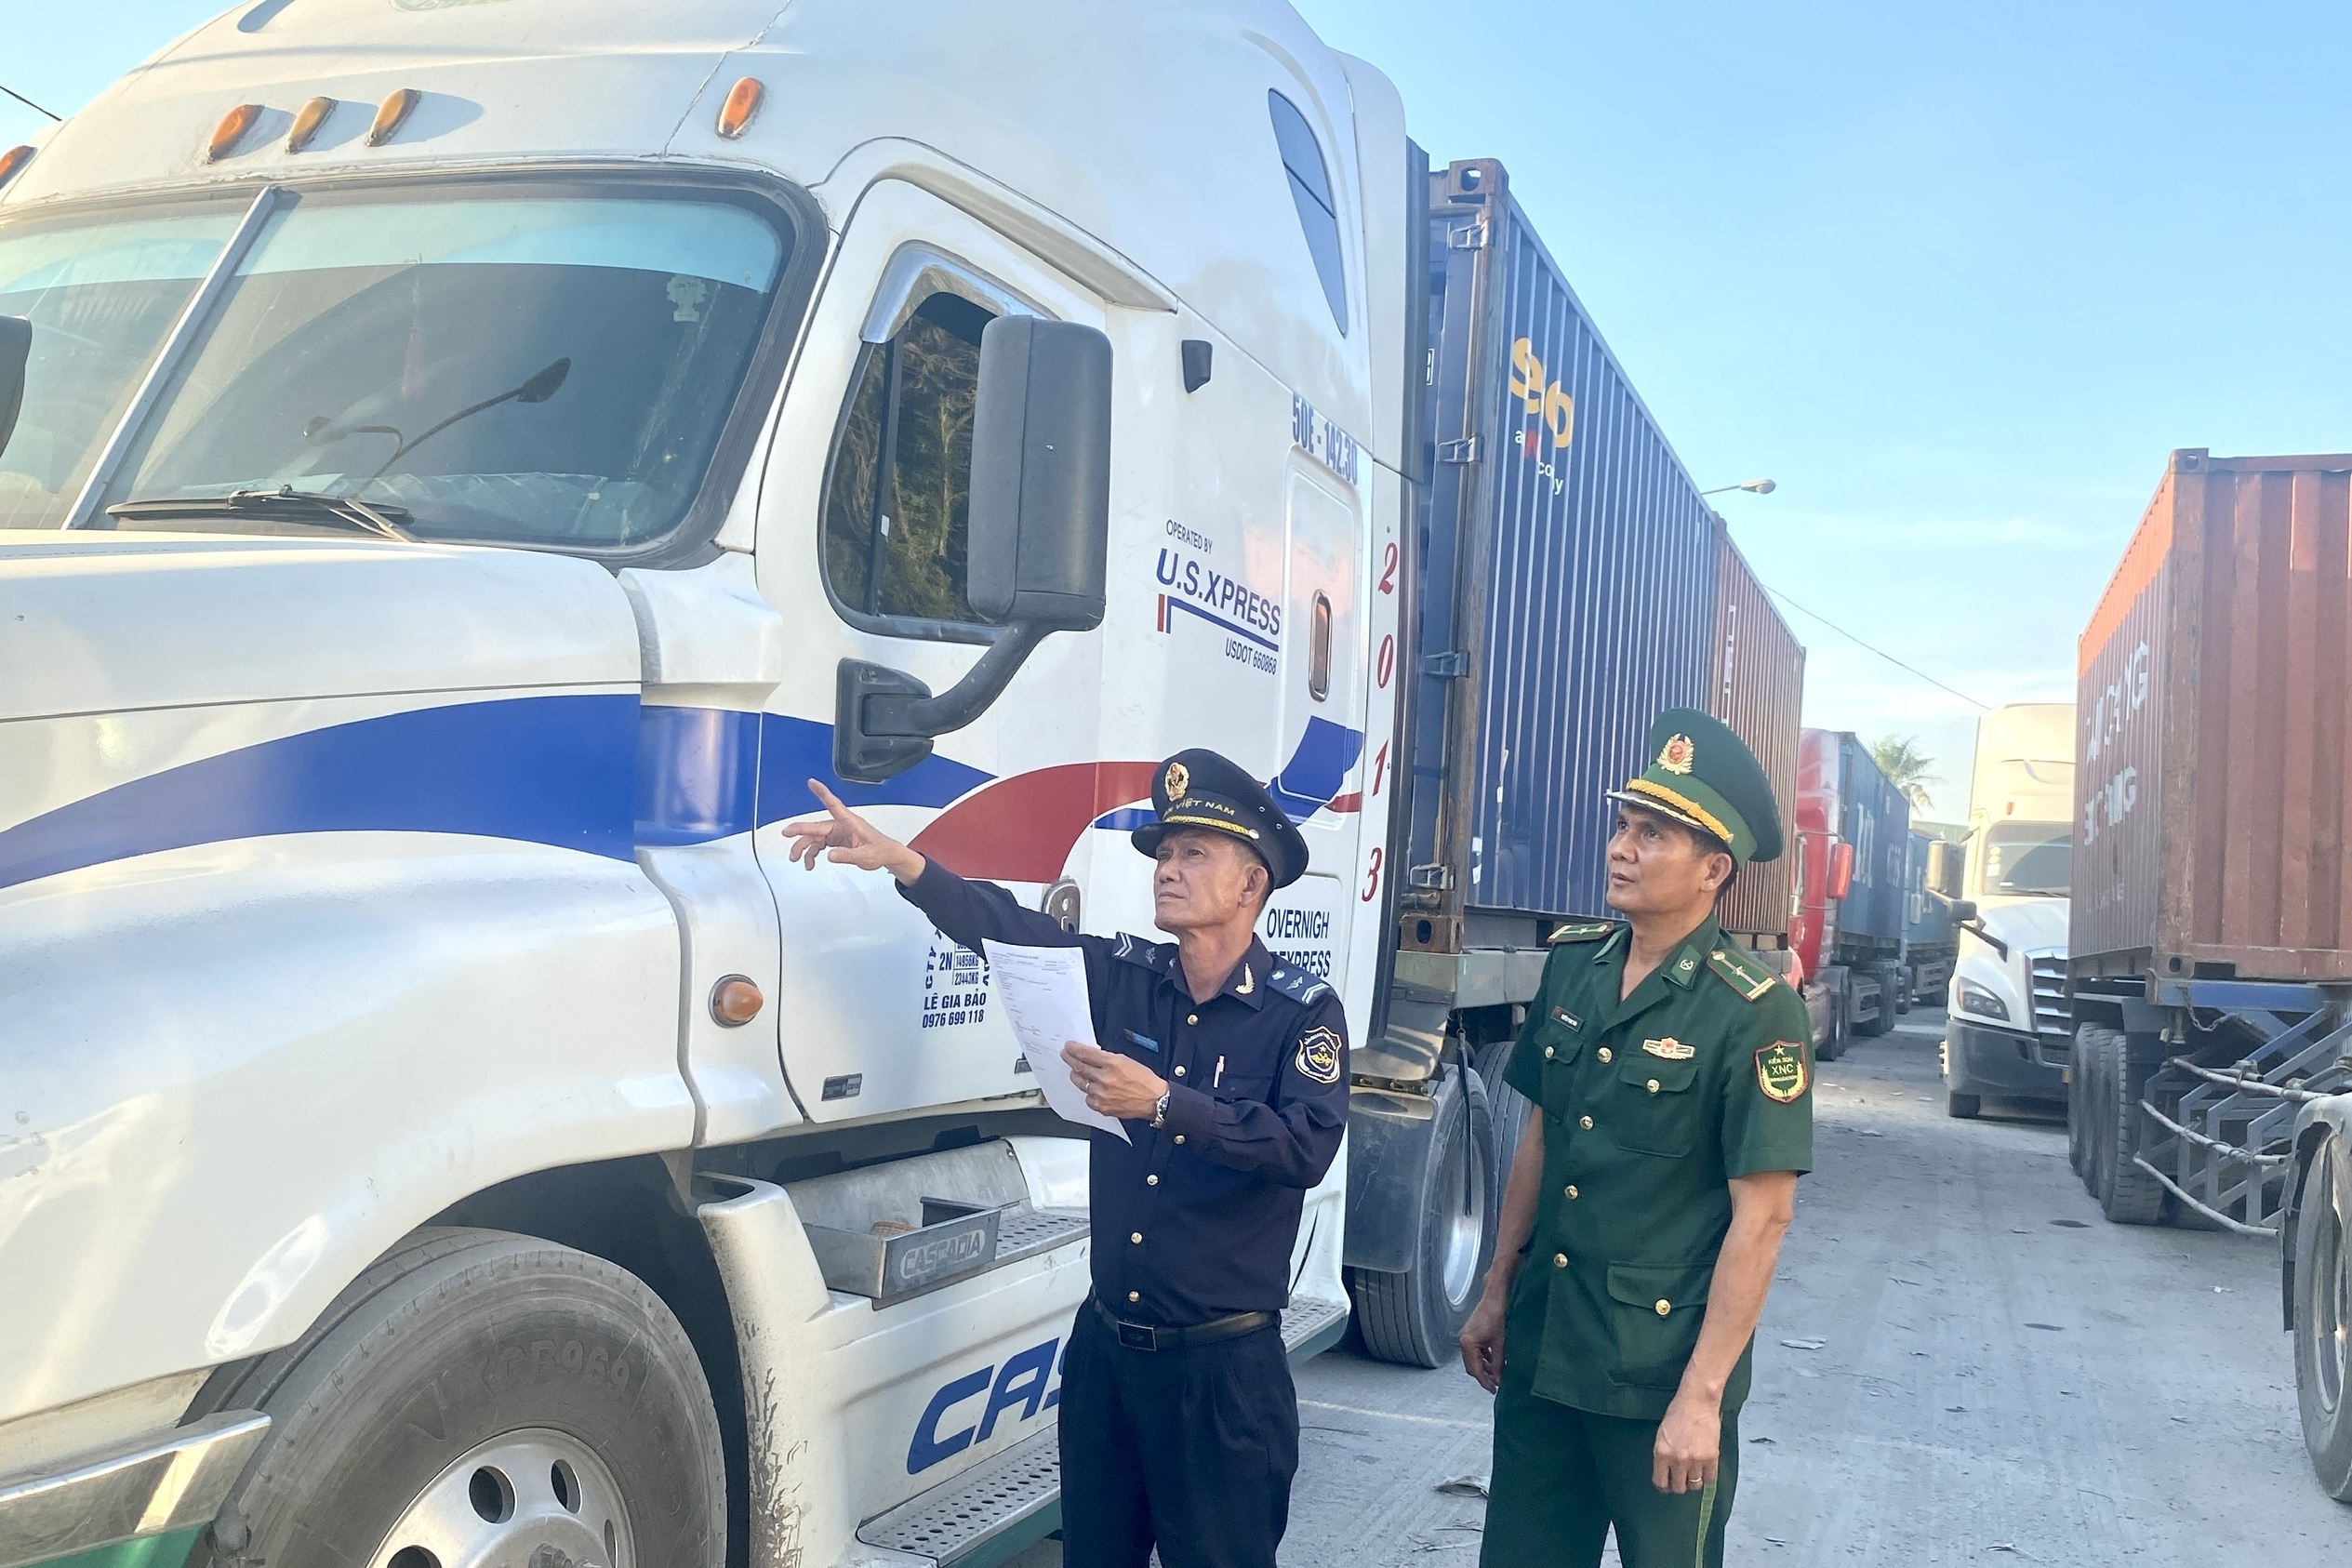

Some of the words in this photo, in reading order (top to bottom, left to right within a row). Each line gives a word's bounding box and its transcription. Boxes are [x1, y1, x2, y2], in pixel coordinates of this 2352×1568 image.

[1293, 392, 1313, 454] 50E
[1324, 420, 1358, 485] 142.30
[1166, 519, 1203, 550] OPERATED
[1204, 537, 1213, 554] BY
[1156, 548, 1281, 635] U.S.XPRESS
[1225, 637, 1253, 665] USDOT
[1205, 801, 1236, 816] NAM
[1267, 908, 1330, 938] OVERNIGH
[939, 951, 952, 970] 2N
[924, 992, 938, 1010] LÊ
[941, 994, 961, 1009] GIA
[963, 988, 987, 1007] BẢO
[923, 1013, 946, 1029] 0976
[949, 1011, 965, 1026] 699
[968, 1009, 984, 1024] 118
[1771, 1063, 1794, 1076] XNC
